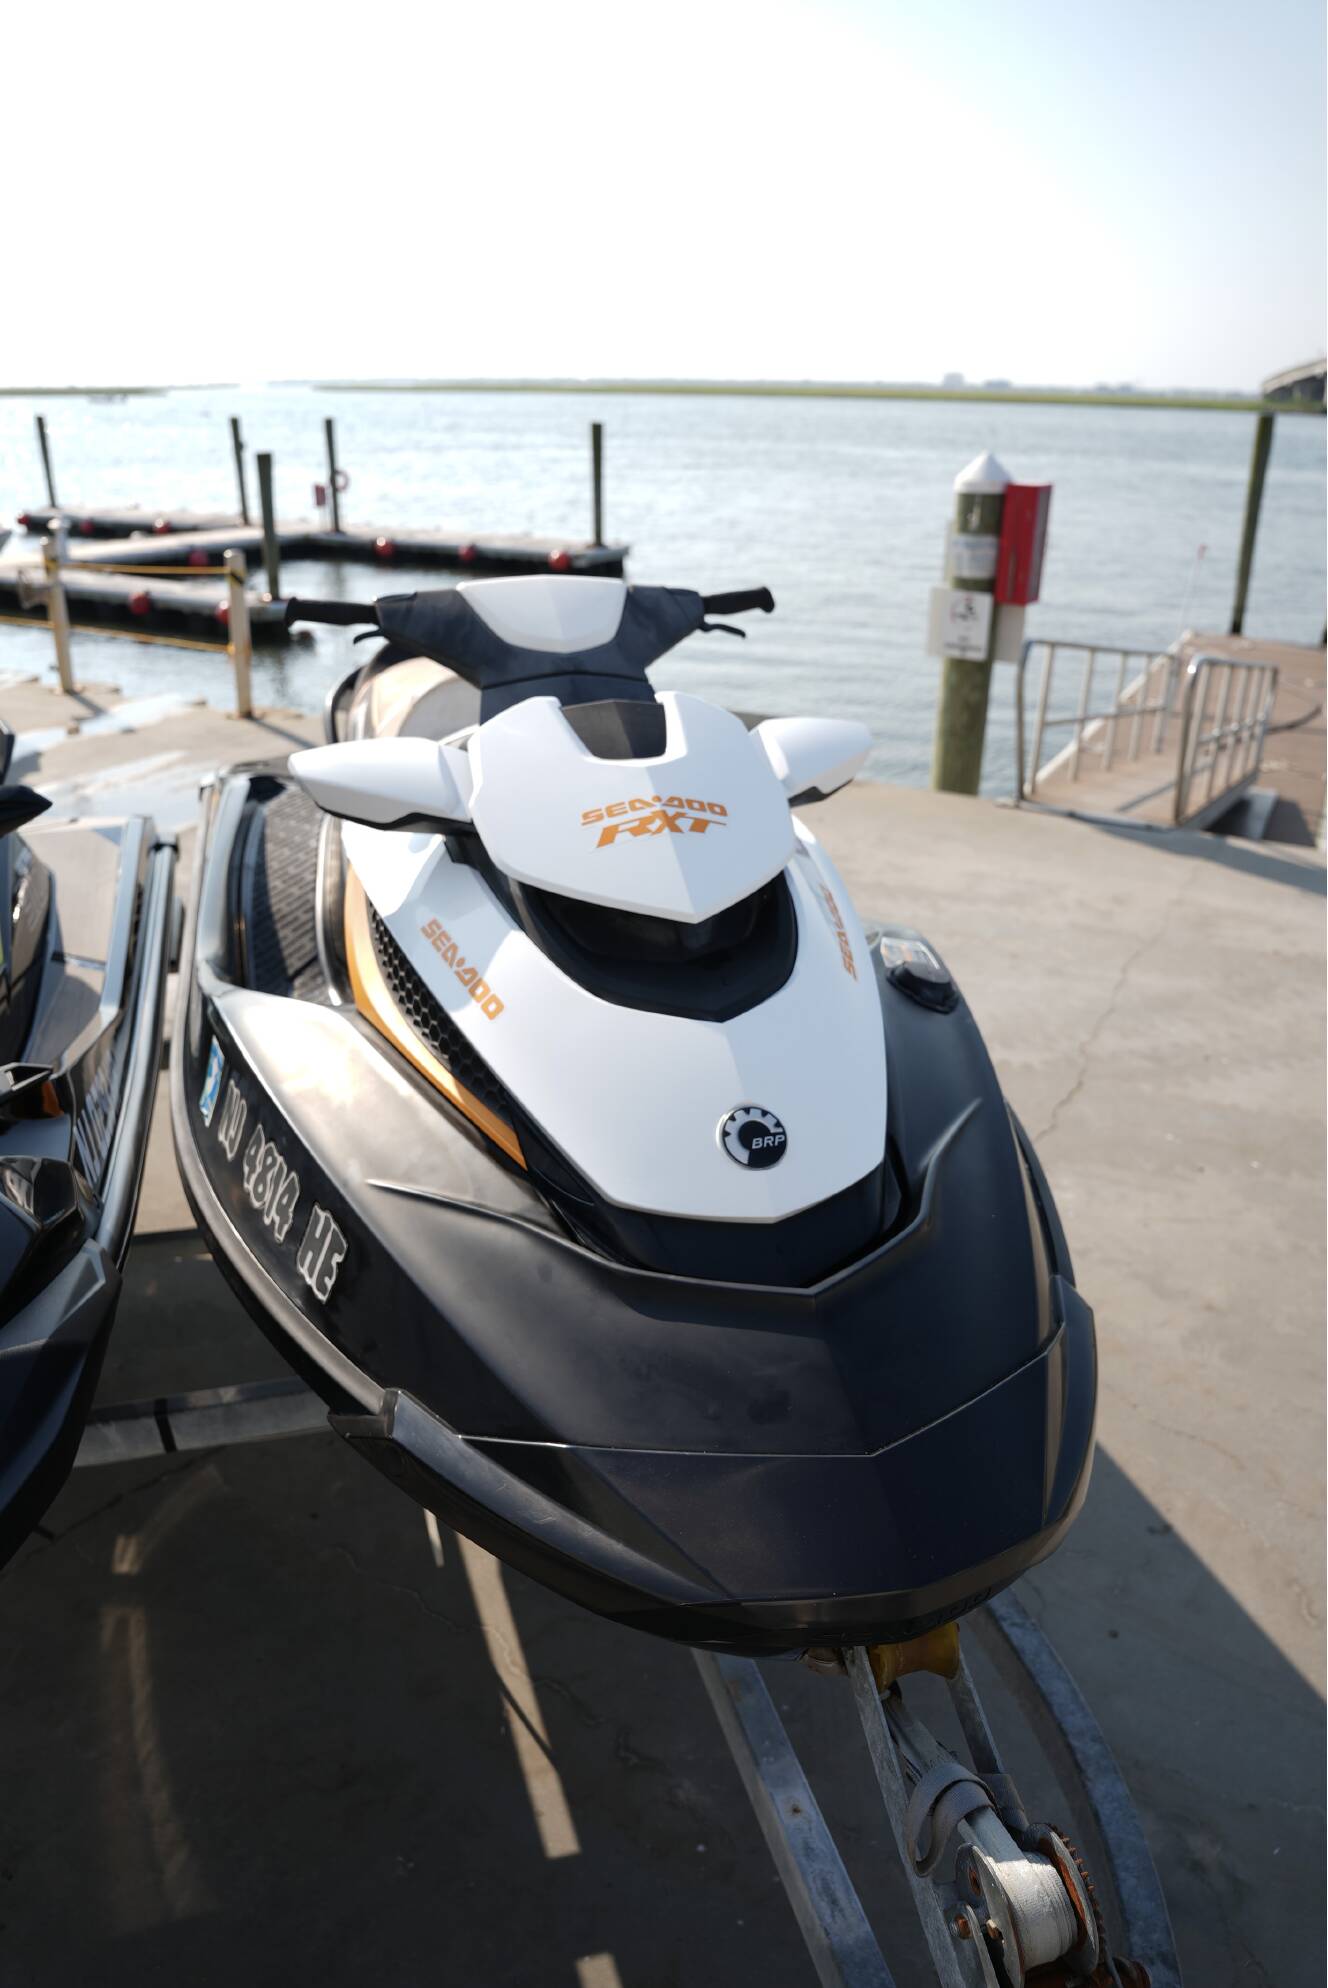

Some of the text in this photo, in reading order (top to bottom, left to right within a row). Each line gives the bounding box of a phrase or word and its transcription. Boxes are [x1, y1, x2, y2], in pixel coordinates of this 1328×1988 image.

[596, 809, 727, 848] RXT
[751, 1134, 786, 1150] BRP
[296, 1202, 348, 1305] HE
